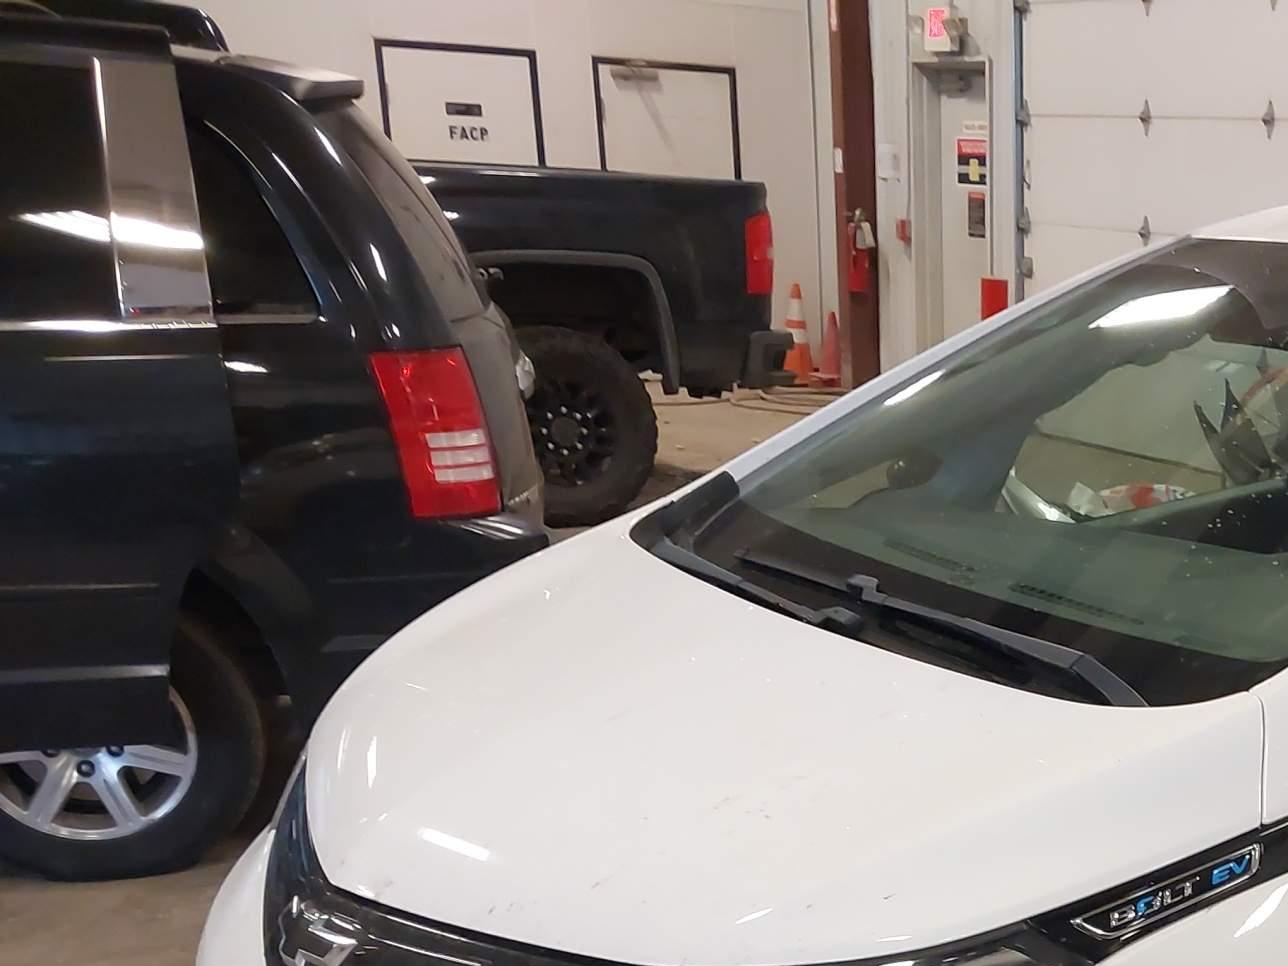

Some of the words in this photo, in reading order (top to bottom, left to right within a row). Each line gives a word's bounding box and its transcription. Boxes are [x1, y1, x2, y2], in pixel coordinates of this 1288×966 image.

[448, 125, 489, 141] FACP
[1109, 875, 1200, 928] BOLT
[1211, 854, 1251, 886] EV
